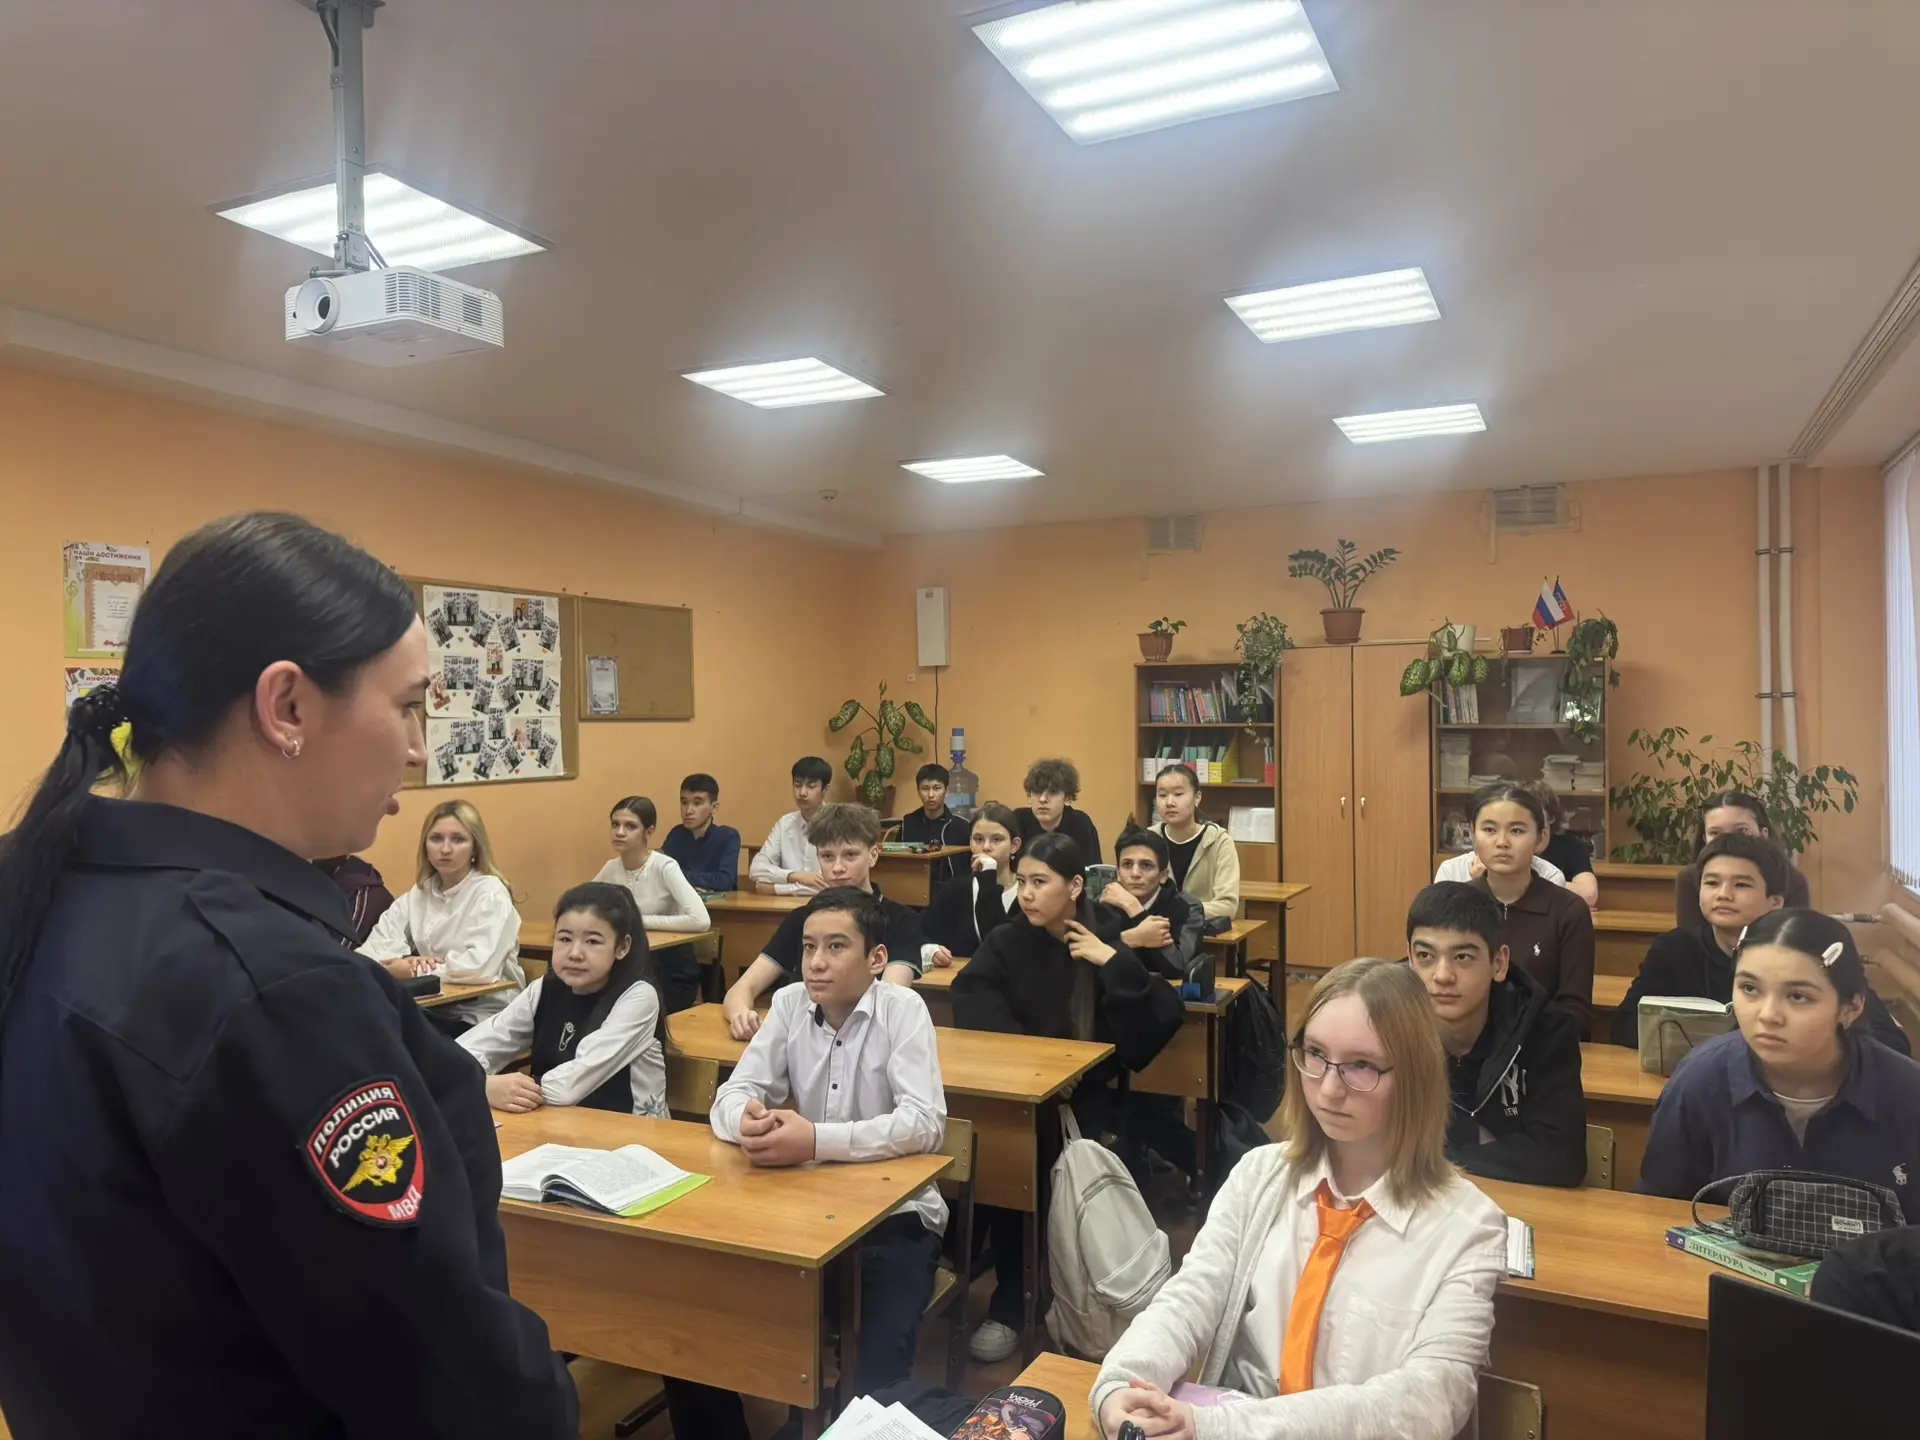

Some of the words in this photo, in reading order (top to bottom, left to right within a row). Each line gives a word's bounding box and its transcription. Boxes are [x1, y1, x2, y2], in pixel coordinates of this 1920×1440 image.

[313, 1086, 395, 1155] ПОЛИЦИЯ
[328, 1107, 400, 1169] РОССИЯ
[387, 1184, 422, 1220] МВД
[1689, 1240, 1744, 1270] ЛИТЕРАТУРА
